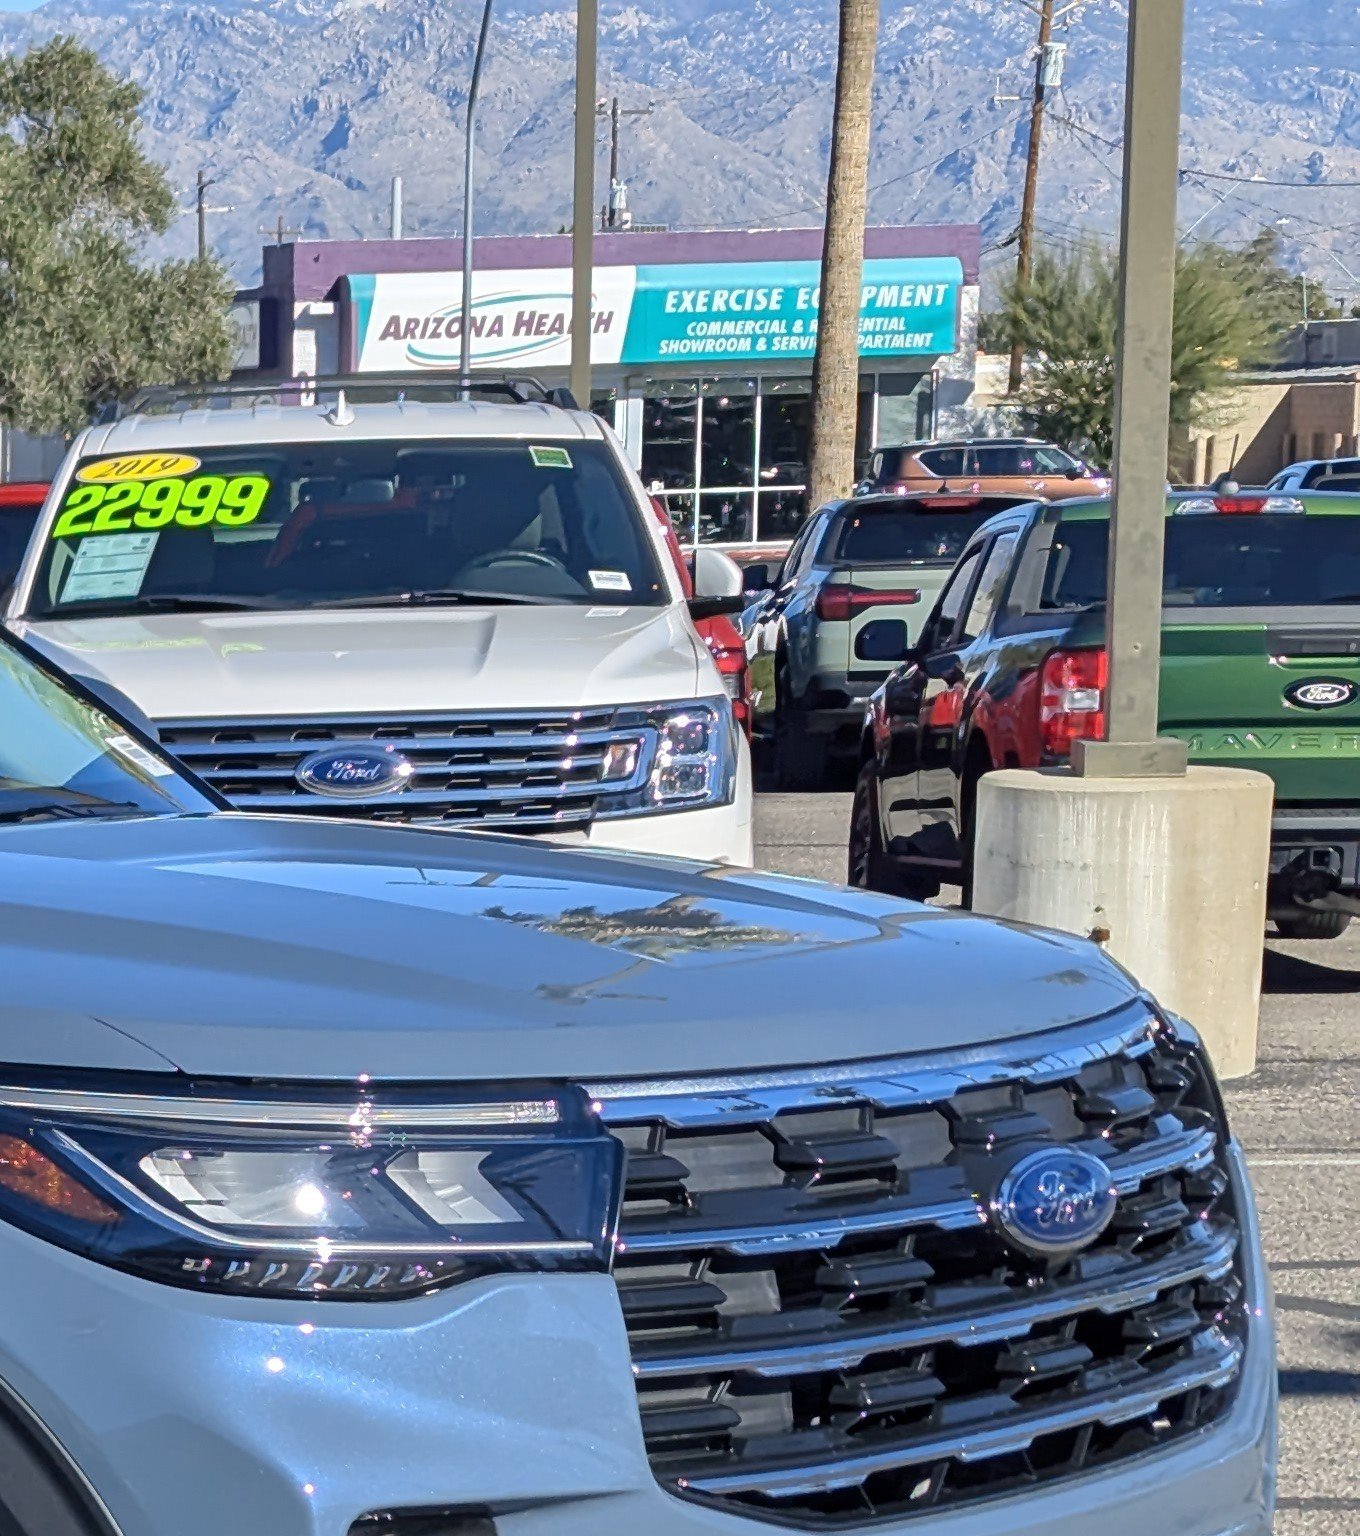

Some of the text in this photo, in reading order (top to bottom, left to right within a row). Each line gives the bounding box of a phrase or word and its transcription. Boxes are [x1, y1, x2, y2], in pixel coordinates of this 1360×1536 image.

[665, 284, 949, 313] EXERCISE EPMENT
[379, 310, 615, 341] ARIZONA HEAH
[687, 319, 787, 336] COMMERCIAL
[792, 319, 804, 333] &
[659, 337, 751, 354] SHOWROOM
[756, 337, 767, 352] &
[772, 334, 817, 351] SERVI
[93, 457, 181, 479] 2019
[52, 476, 271, 538] 22999
[1306, 686, 1340, 700] Ford
[326, 759, 381, 780] Ford
